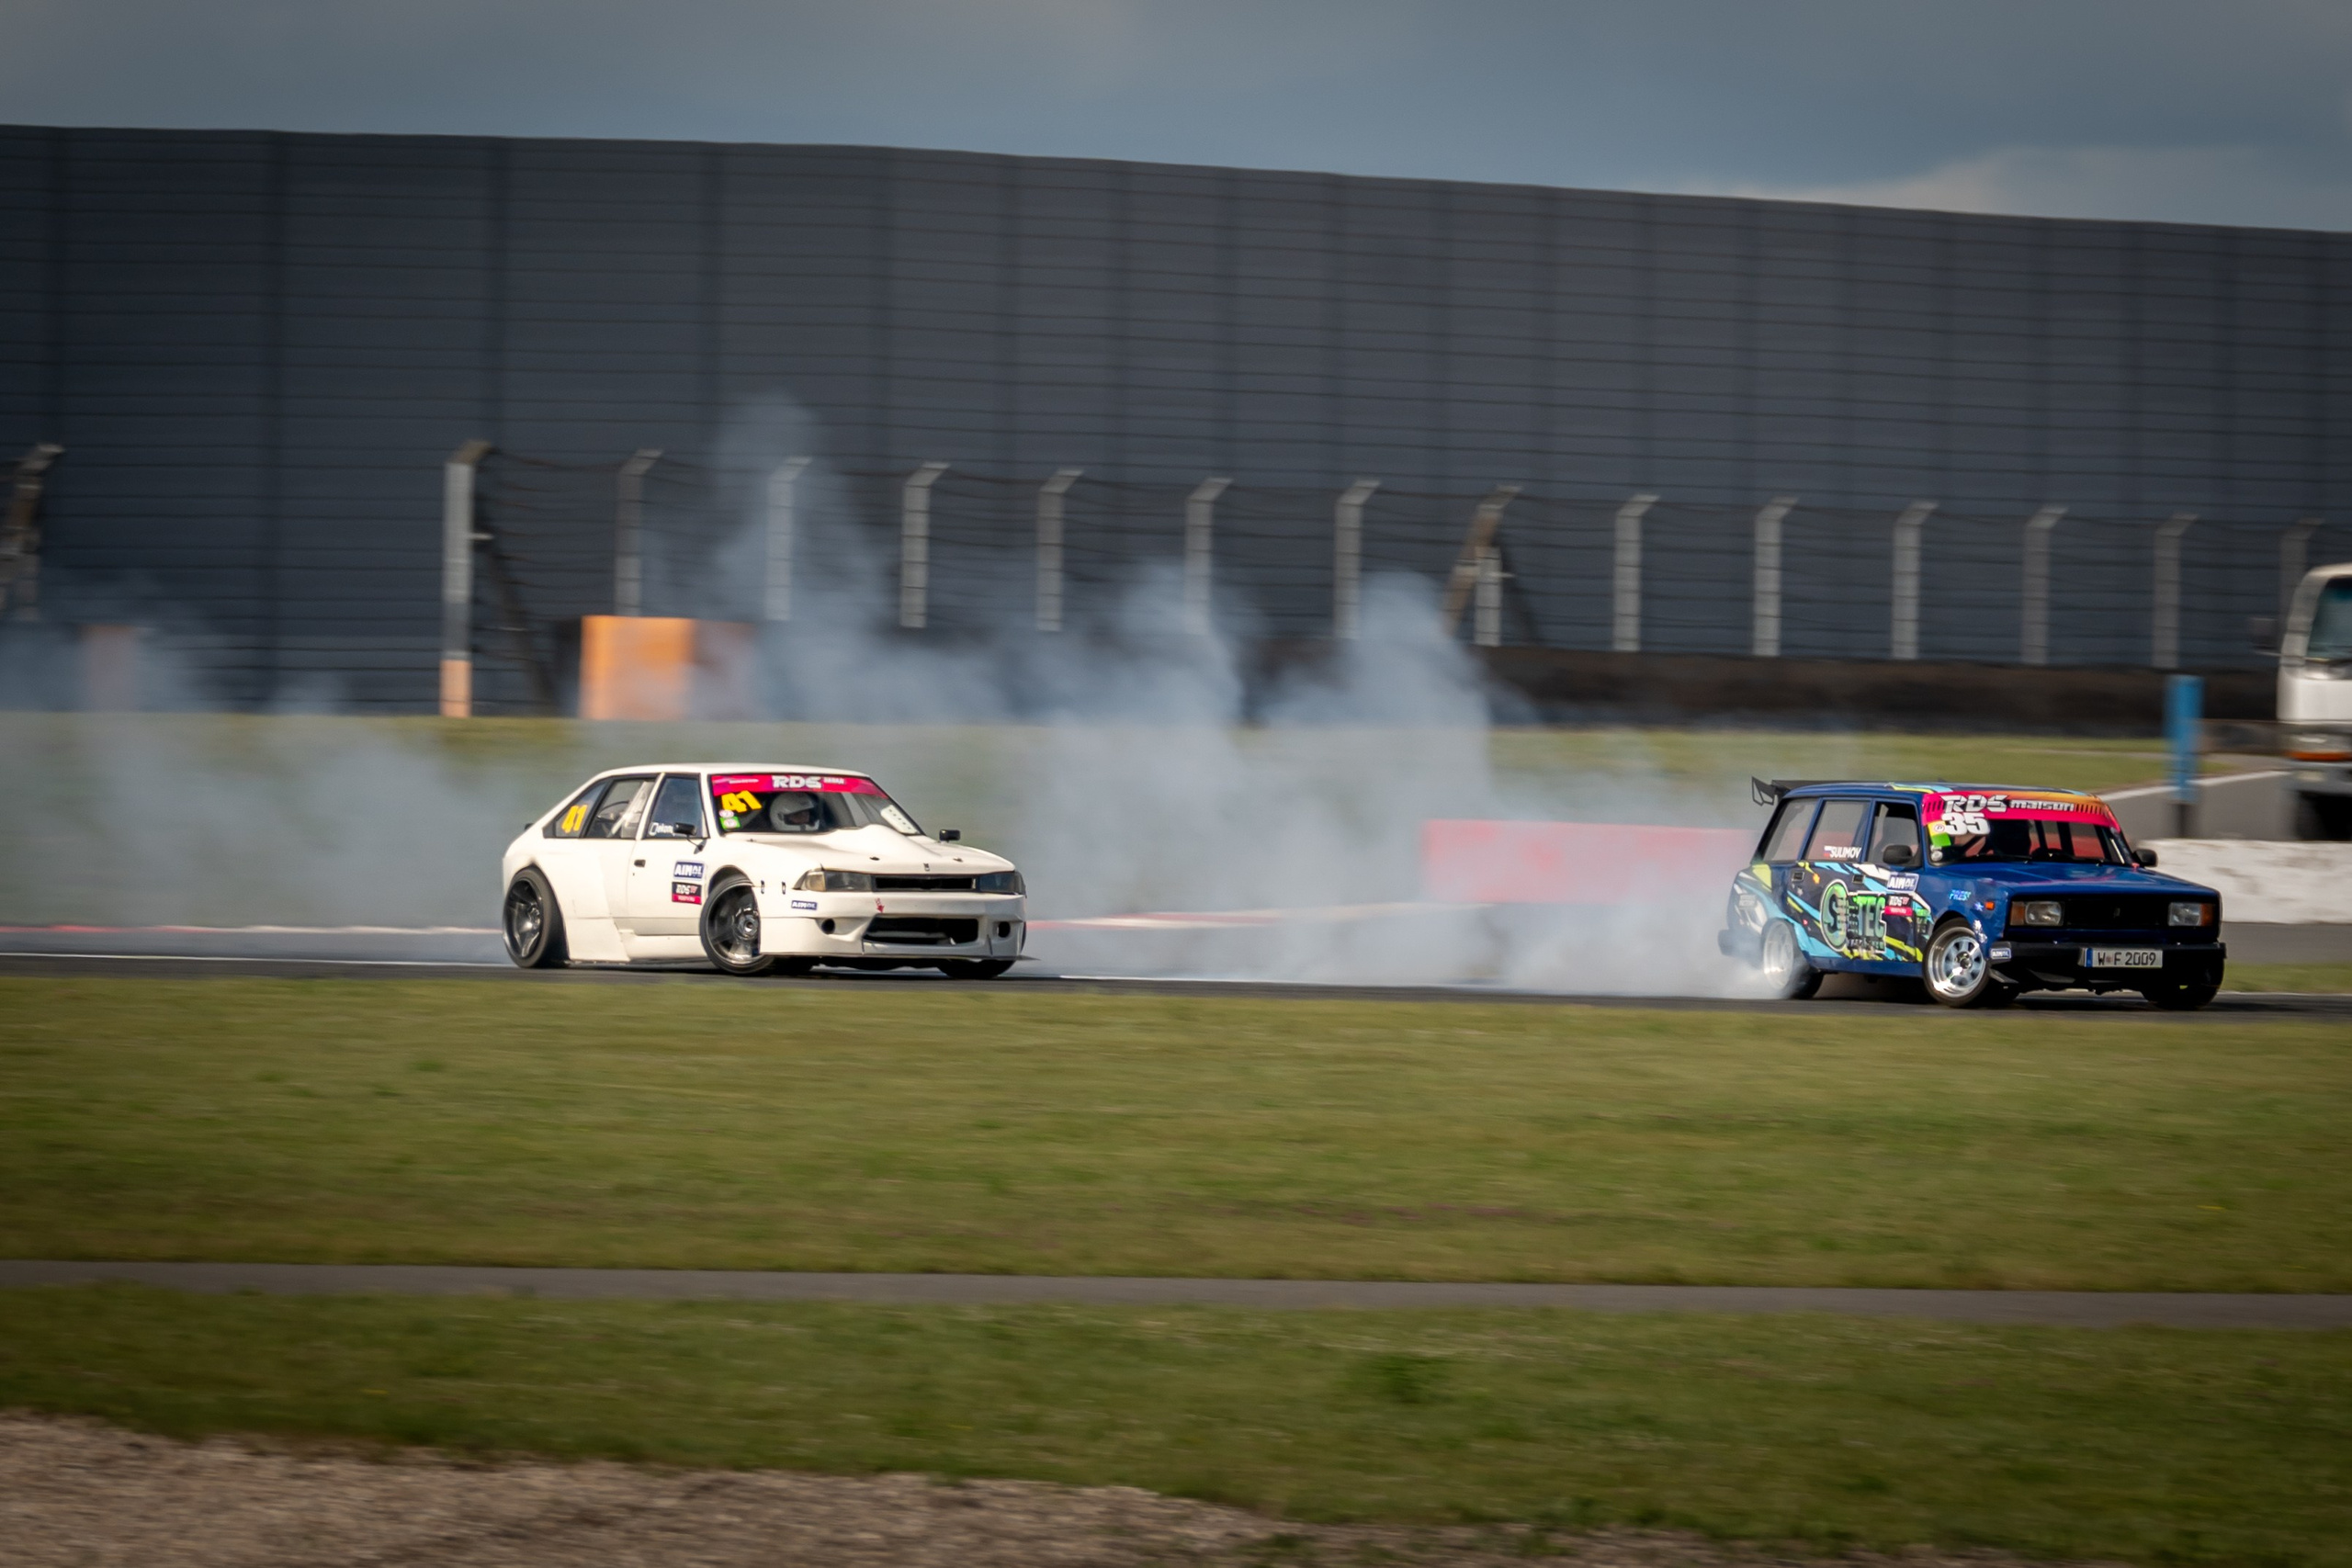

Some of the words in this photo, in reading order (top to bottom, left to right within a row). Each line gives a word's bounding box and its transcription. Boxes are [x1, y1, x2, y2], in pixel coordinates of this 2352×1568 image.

[772, 775, 822, 788] RDS
[721, 790, 763, 813] 41
[1941, 795, 2008, 813] RDS
[561, 805, 587, 833] 41
[1941, 812, 1990, 835] 35
[2098, 952, 2106, 965] W
[2114, 952, 2122, 965] F
[2125, 952, 2156, 965] 2009
